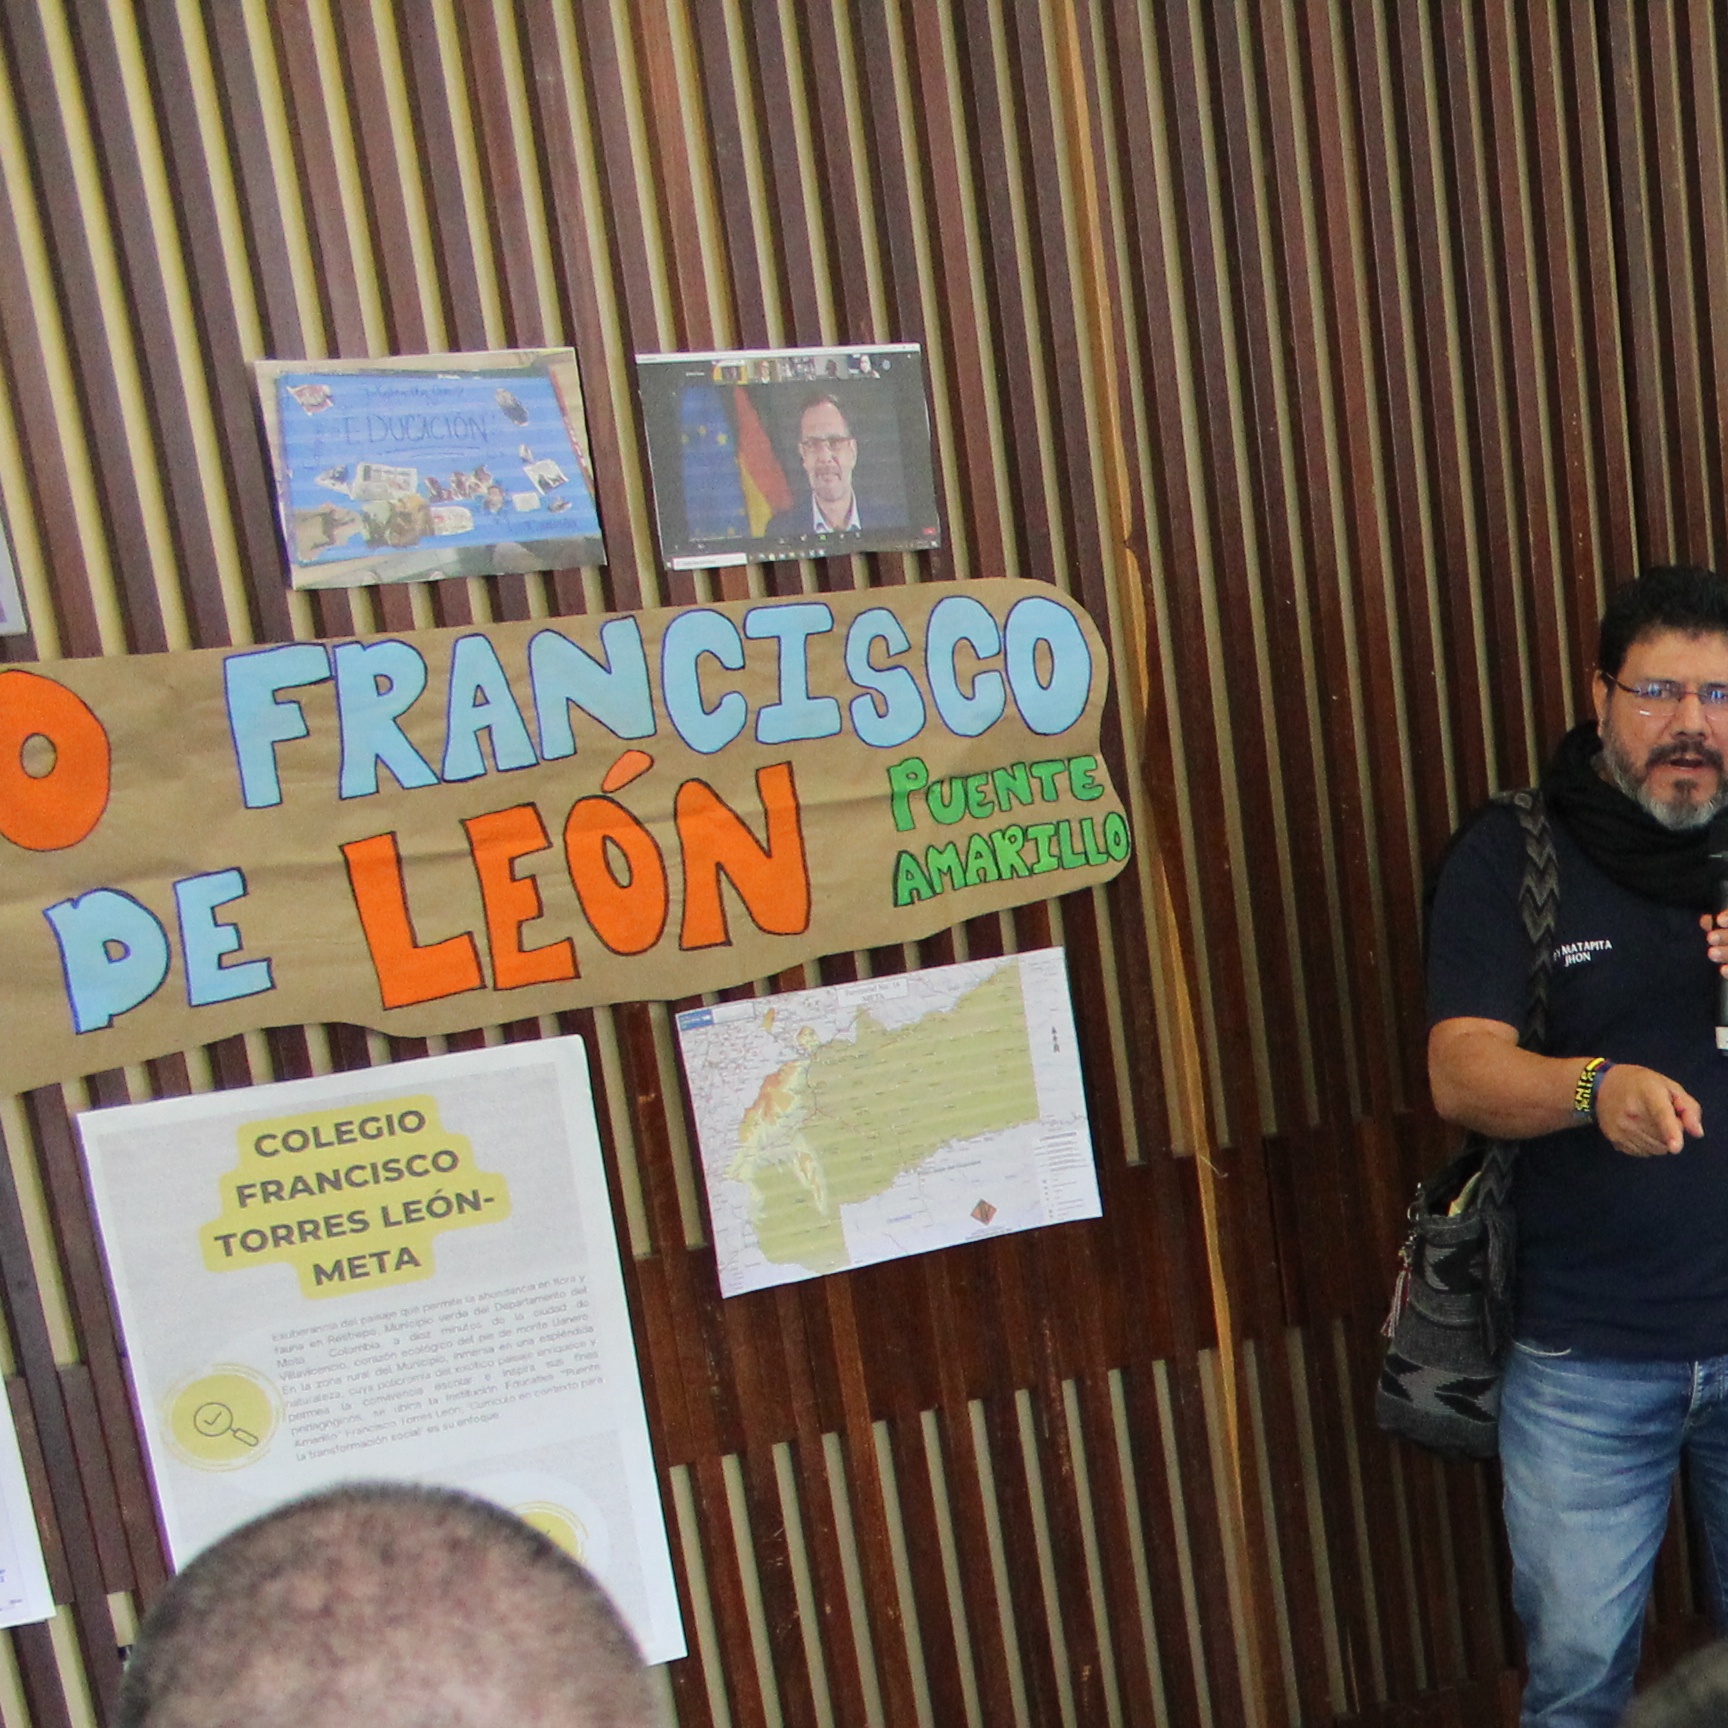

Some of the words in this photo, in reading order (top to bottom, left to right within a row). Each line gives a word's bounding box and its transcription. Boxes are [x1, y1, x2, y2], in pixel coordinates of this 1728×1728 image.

[223, 595, 1093, 811] FRANCISCO
[887, 755, 1105, 831] PUENTE
[43, 867, 274, 1035] DE
[339, 749, 811, 1010] LEÓN
[891, 811, 1132, 908] AMARILLO
[1564, 951, 1592, 967] JHON
[253, 1109, 427, 1158] COLEGIO
[235, 1149, 460, 1209] FRANCISCO
[213, 1207, 371, 1259] TORRES
[381, 1188, 497, 1233] LEÓN-
[312, 1246, 422, 1288] META
